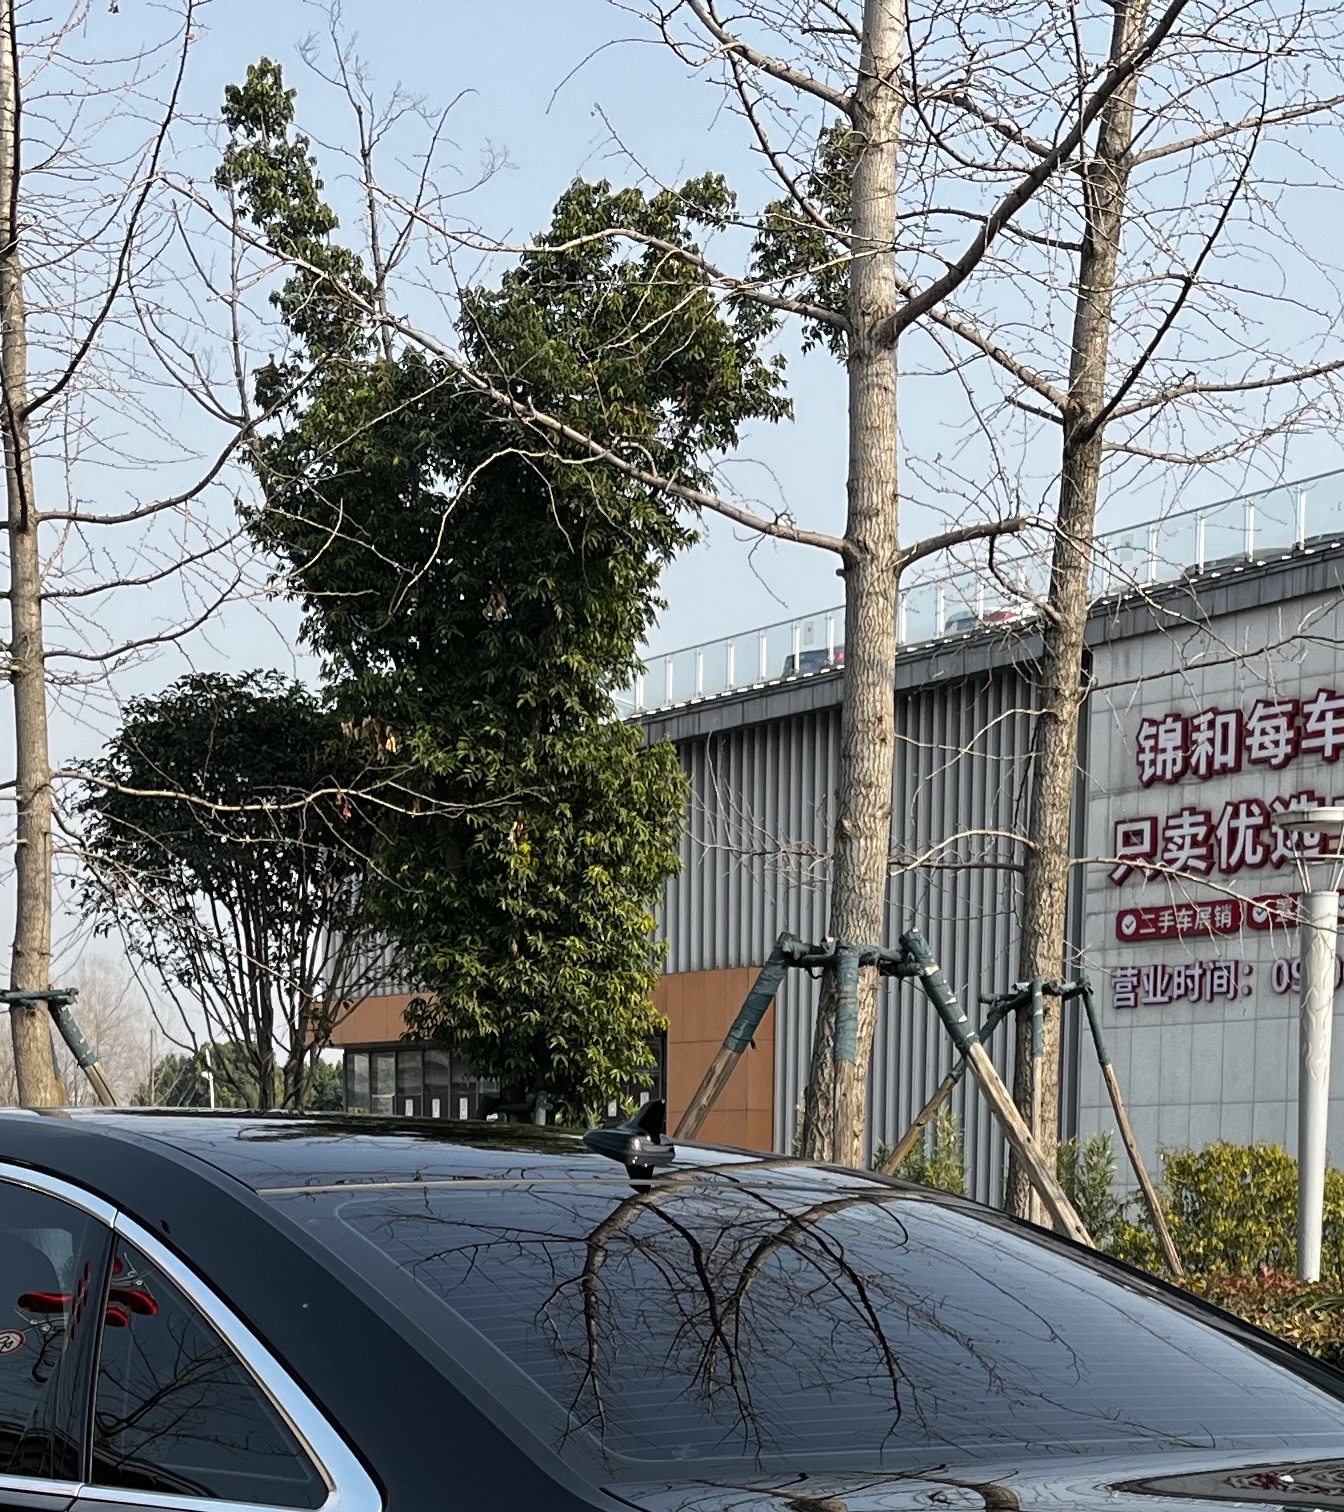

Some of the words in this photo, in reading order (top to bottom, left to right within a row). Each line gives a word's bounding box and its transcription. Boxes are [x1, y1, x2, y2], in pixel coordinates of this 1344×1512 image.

[1138, 904, 1233, 935] 二手车展销
